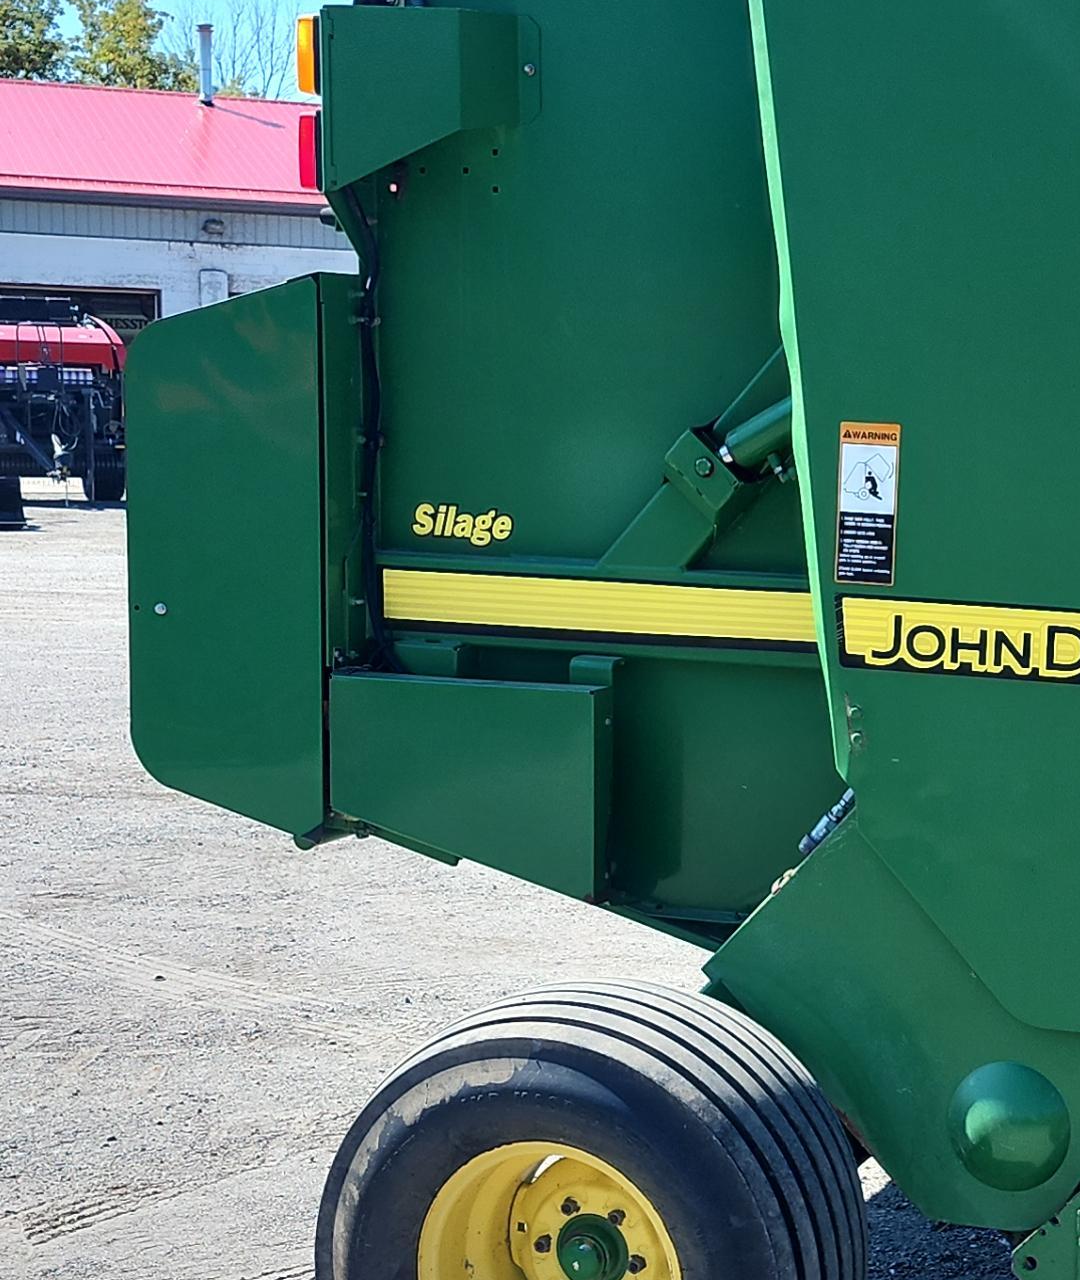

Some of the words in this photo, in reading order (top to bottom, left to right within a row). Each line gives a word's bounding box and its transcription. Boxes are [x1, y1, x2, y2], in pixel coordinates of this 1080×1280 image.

[852, 430, 897, 441] WARNING
[411, 503, 512, 547] Silage
[871, 615, 1032, 669] JOHN
